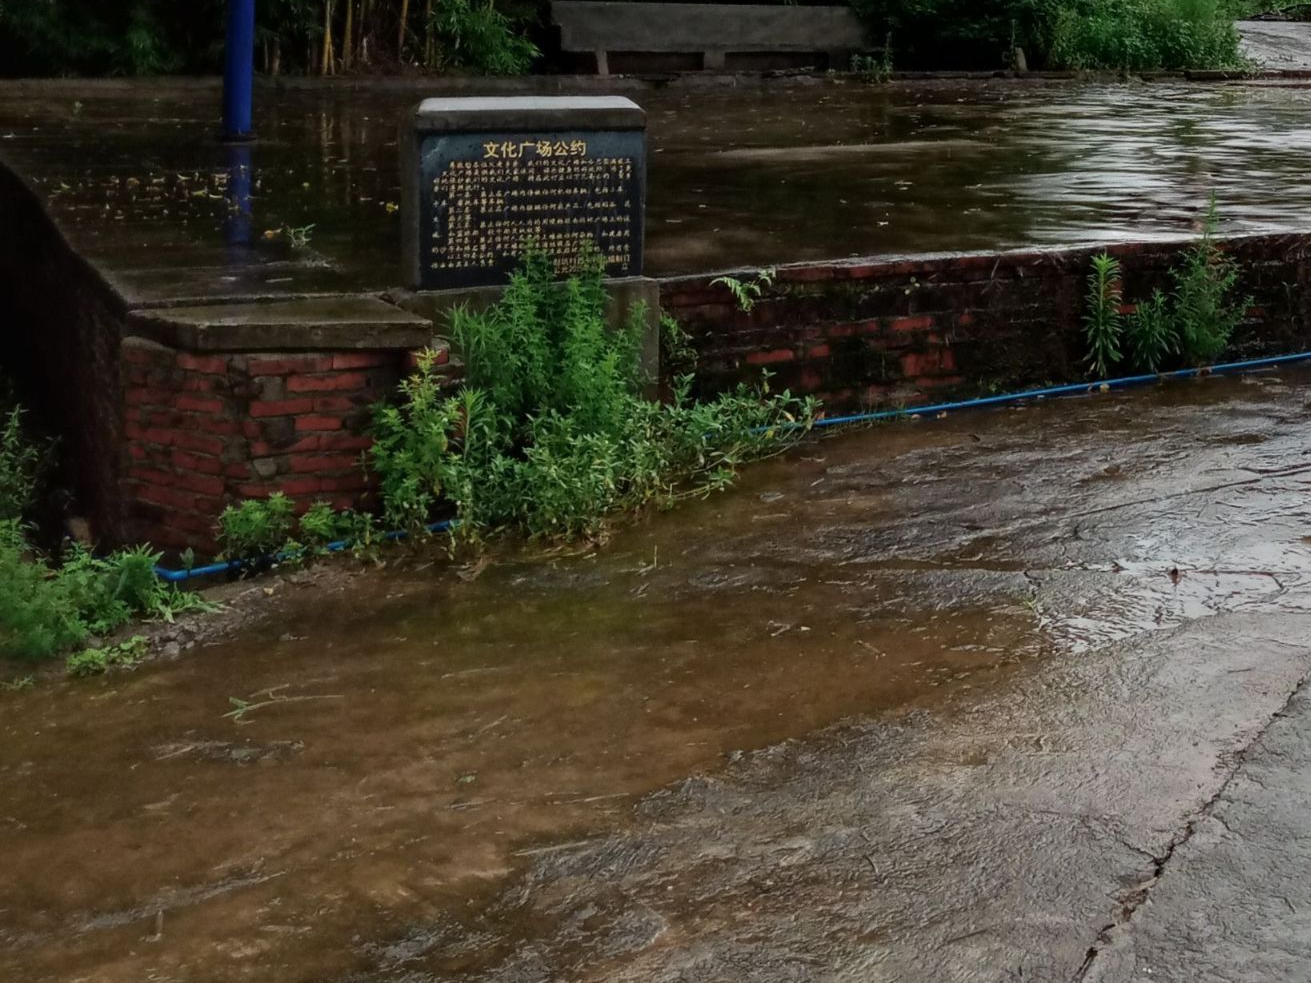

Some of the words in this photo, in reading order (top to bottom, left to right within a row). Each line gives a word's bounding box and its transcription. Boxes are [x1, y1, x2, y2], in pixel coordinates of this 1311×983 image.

[482, 140, 587, 158] 文化广场公约
